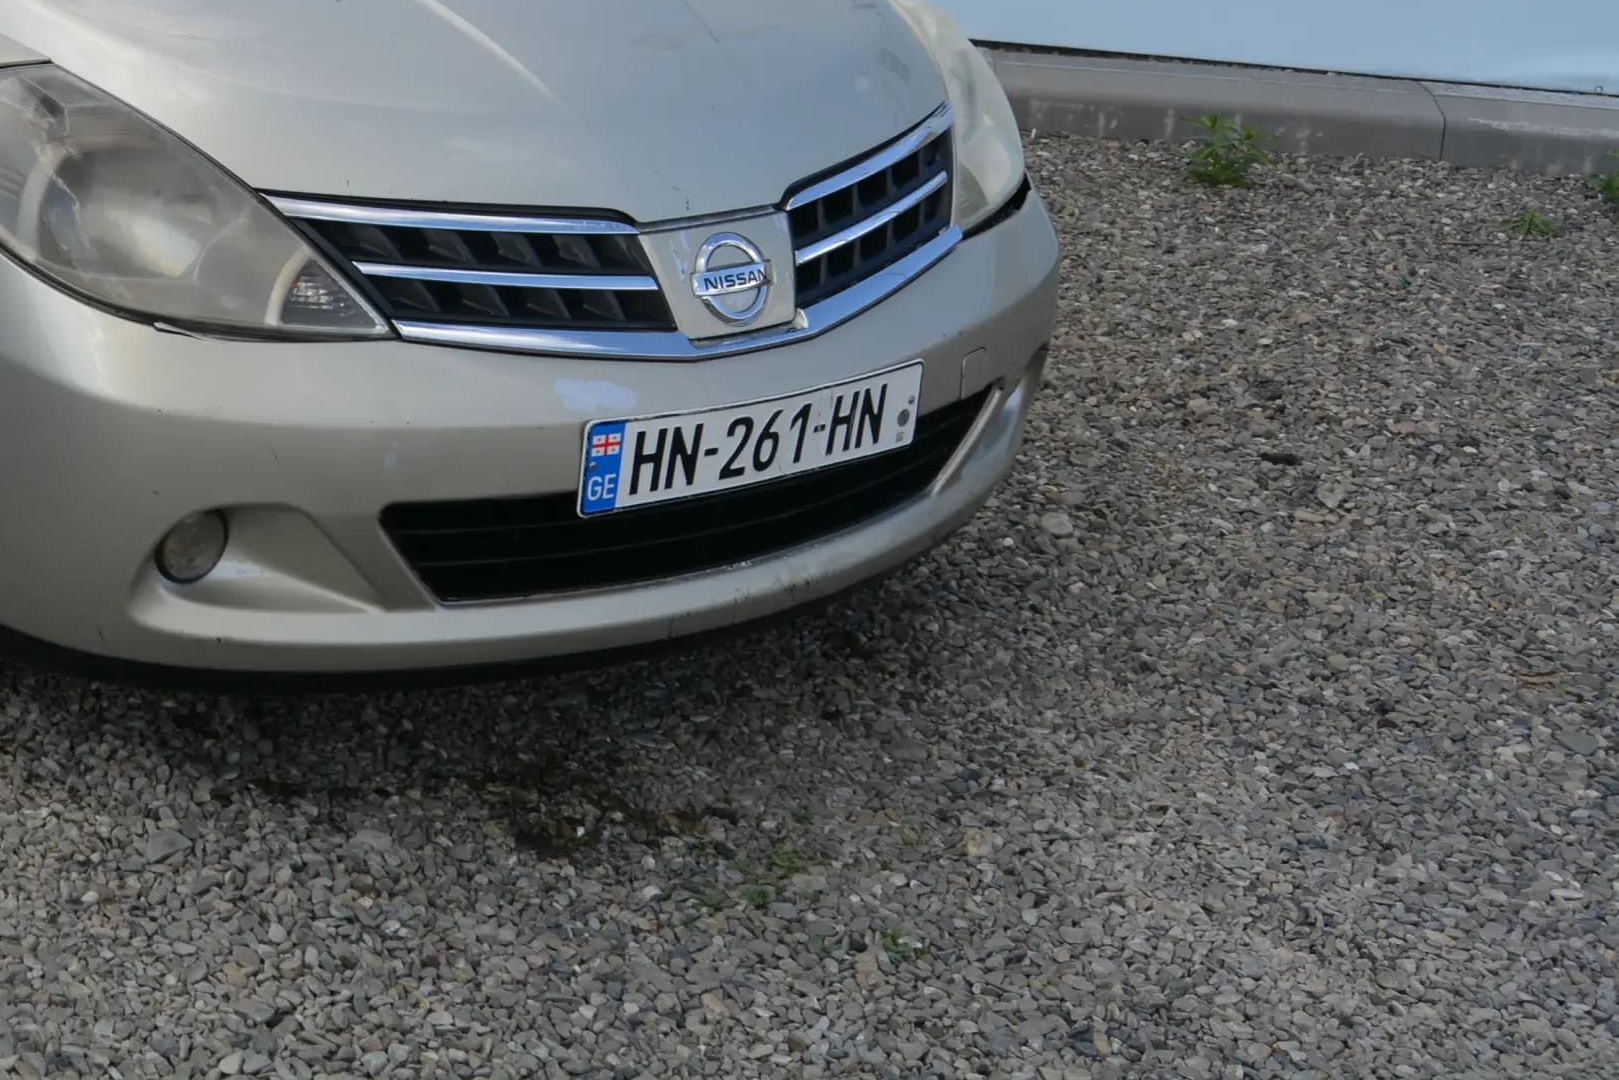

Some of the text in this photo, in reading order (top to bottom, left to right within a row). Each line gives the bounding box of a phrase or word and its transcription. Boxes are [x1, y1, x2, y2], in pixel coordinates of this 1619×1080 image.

[704, 268, 767, 290] NISSAN
[629, 384, 887, 495] HN-261-HN
[587, 474, 616, 500] GE
